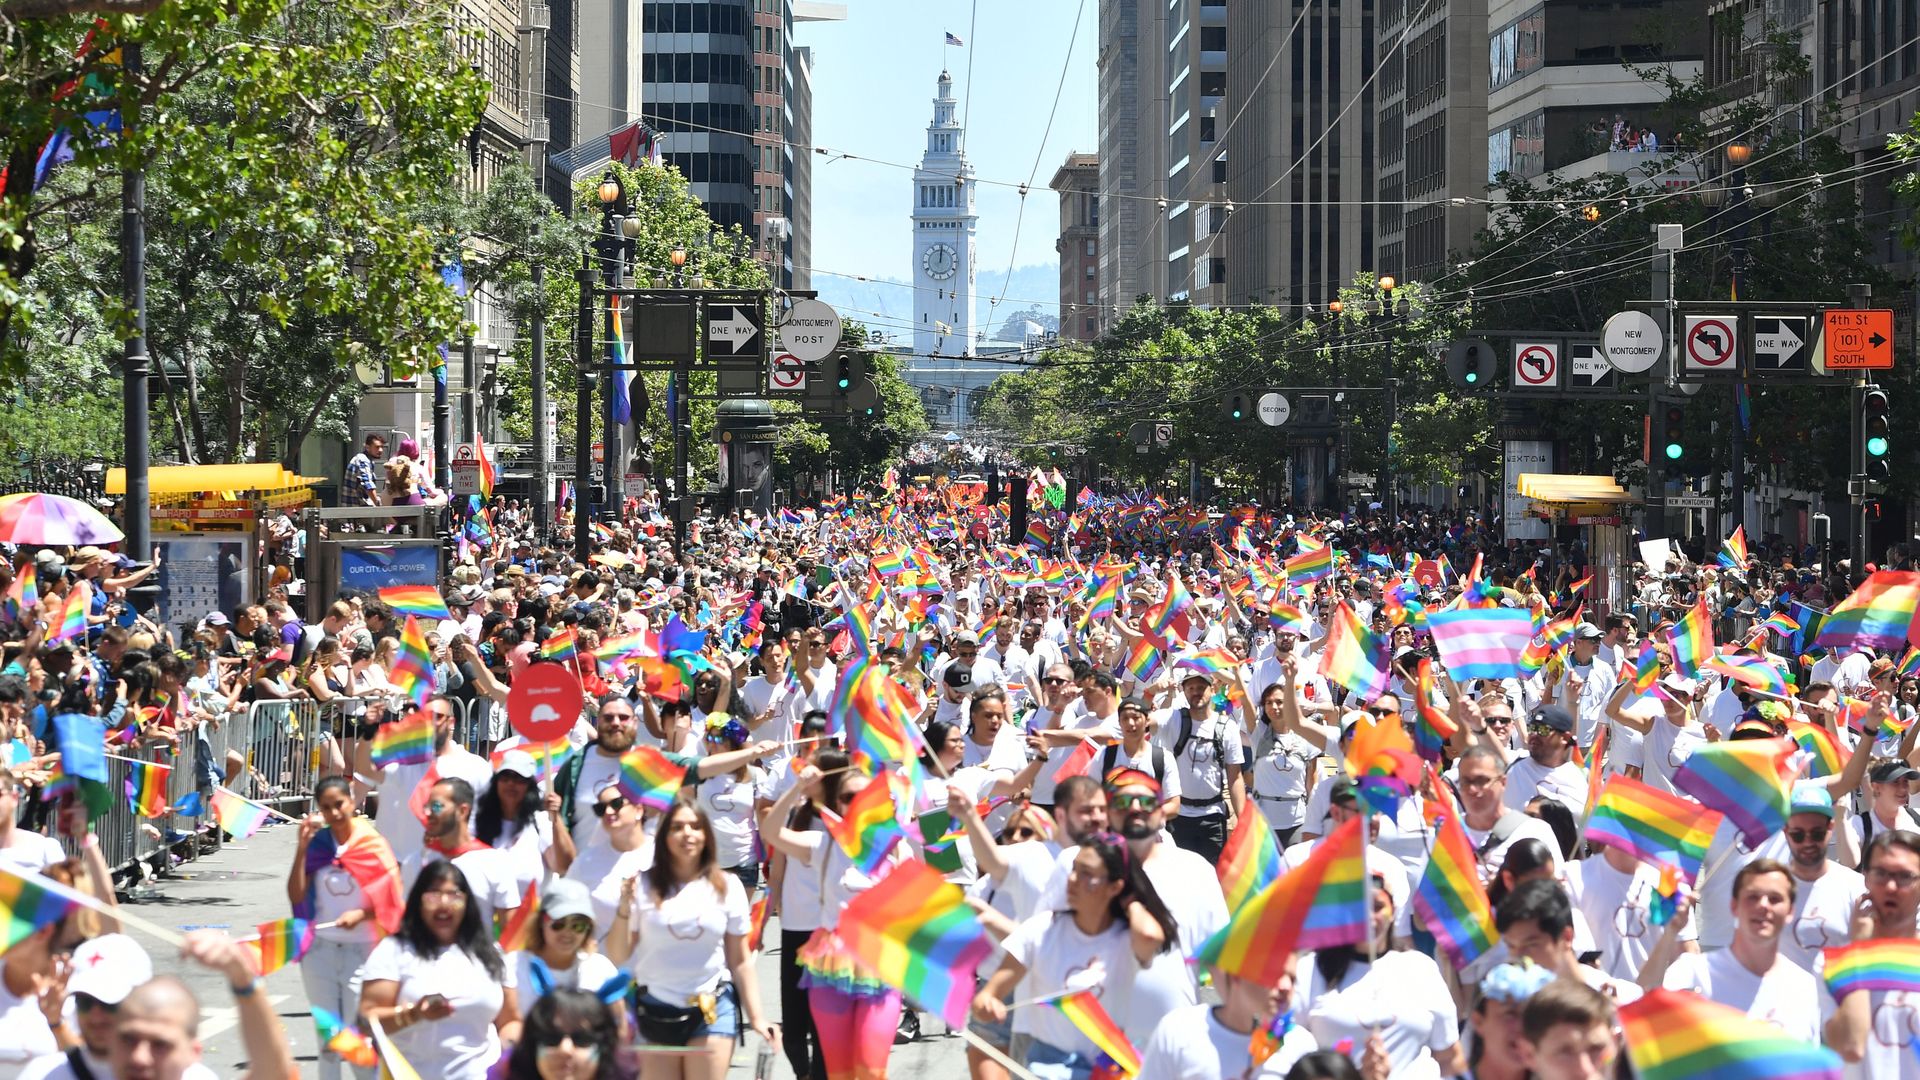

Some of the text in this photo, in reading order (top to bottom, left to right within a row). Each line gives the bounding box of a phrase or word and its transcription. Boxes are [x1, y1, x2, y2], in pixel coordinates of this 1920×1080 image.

[786, 319, 834, 327] MONTGOMERY
[1829, 314, 1868, 325] 4th St
[1624, 330, 1642, 338] NEW
[794, 335, 824, 344] POST
[1841, 334, 1858, 346] 101
[1757, 340, 1799, 348] ONE WAY
[1610, 347, 1656, 355] MONTGOMERY
[1833, 354, 1865, 364] SOUTH
[552, 464, 576, 472] MONTGO
[1682, 499, 1713, 507] MONTGOMERY
[1592, 516, 1613, 525] RAPID
[349, 566, 364, 574] OUR
[382, 564, 398, 573] OUR
